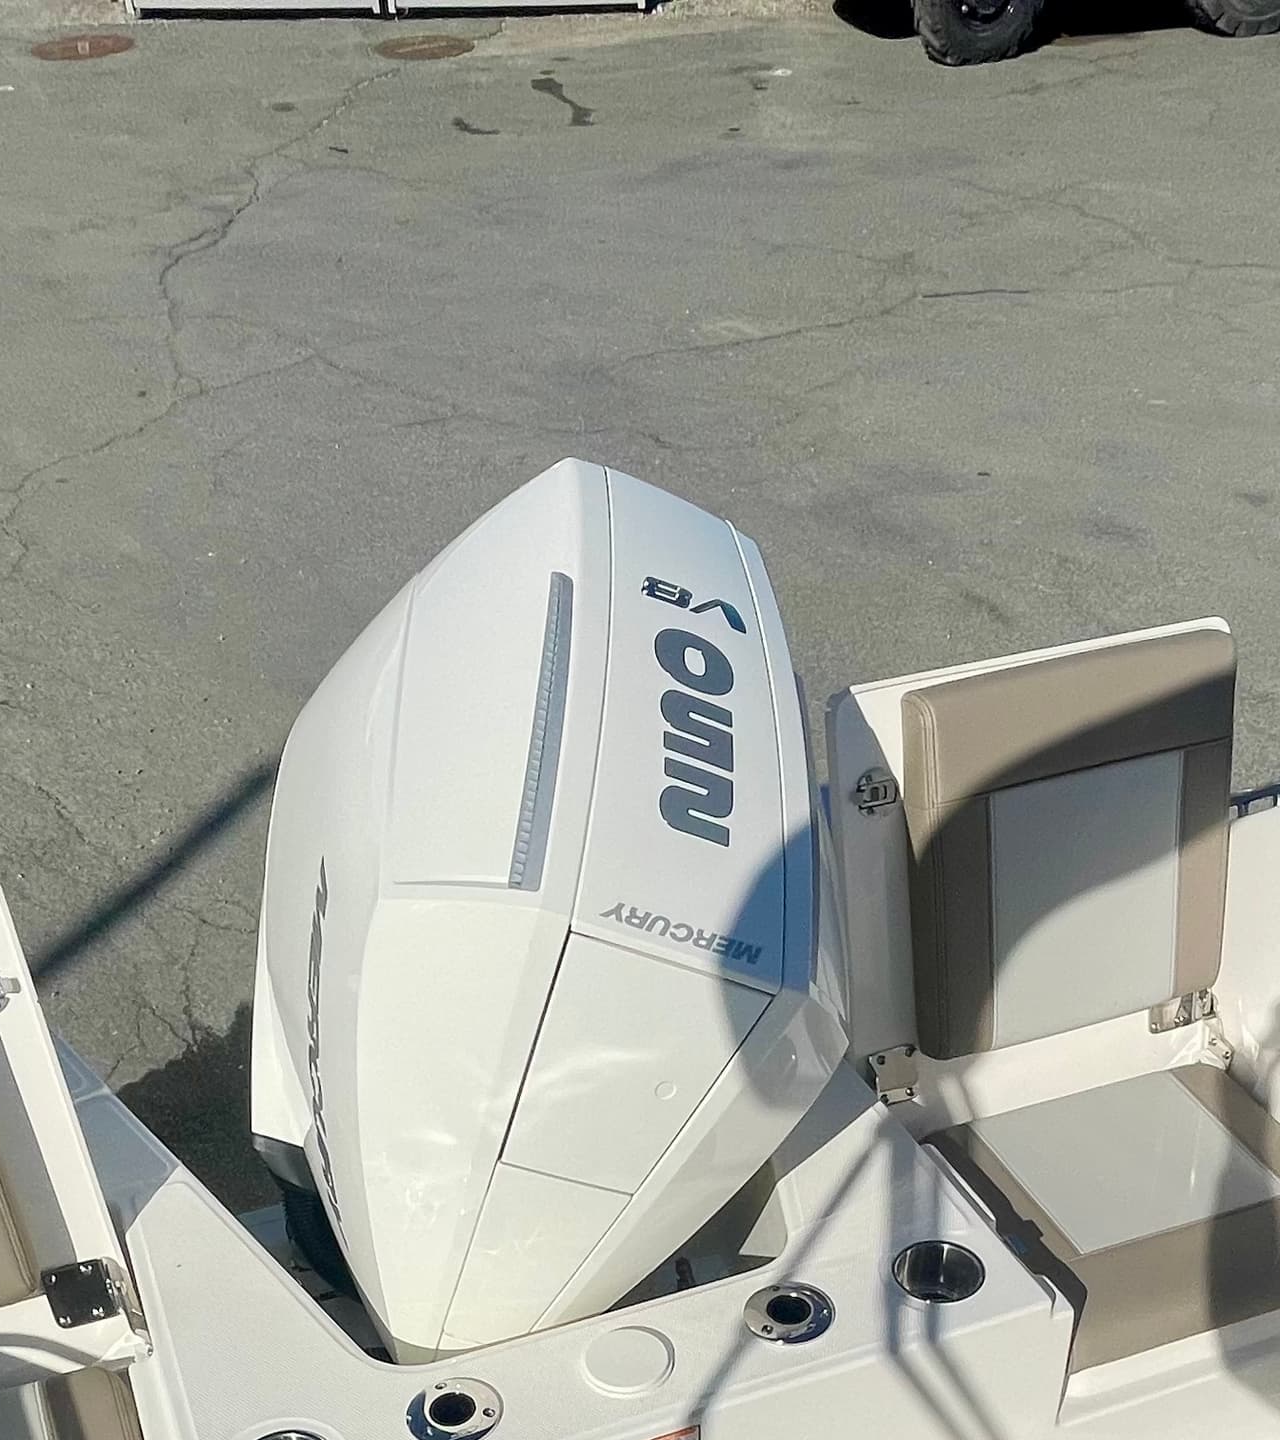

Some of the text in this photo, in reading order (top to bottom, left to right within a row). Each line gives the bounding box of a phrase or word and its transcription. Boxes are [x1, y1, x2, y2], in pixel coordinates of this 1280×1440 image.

[641, 576, 747, 634] V8
[654, 628, 734, 848] 250
[599, 902, 762, 965] MERCURY
